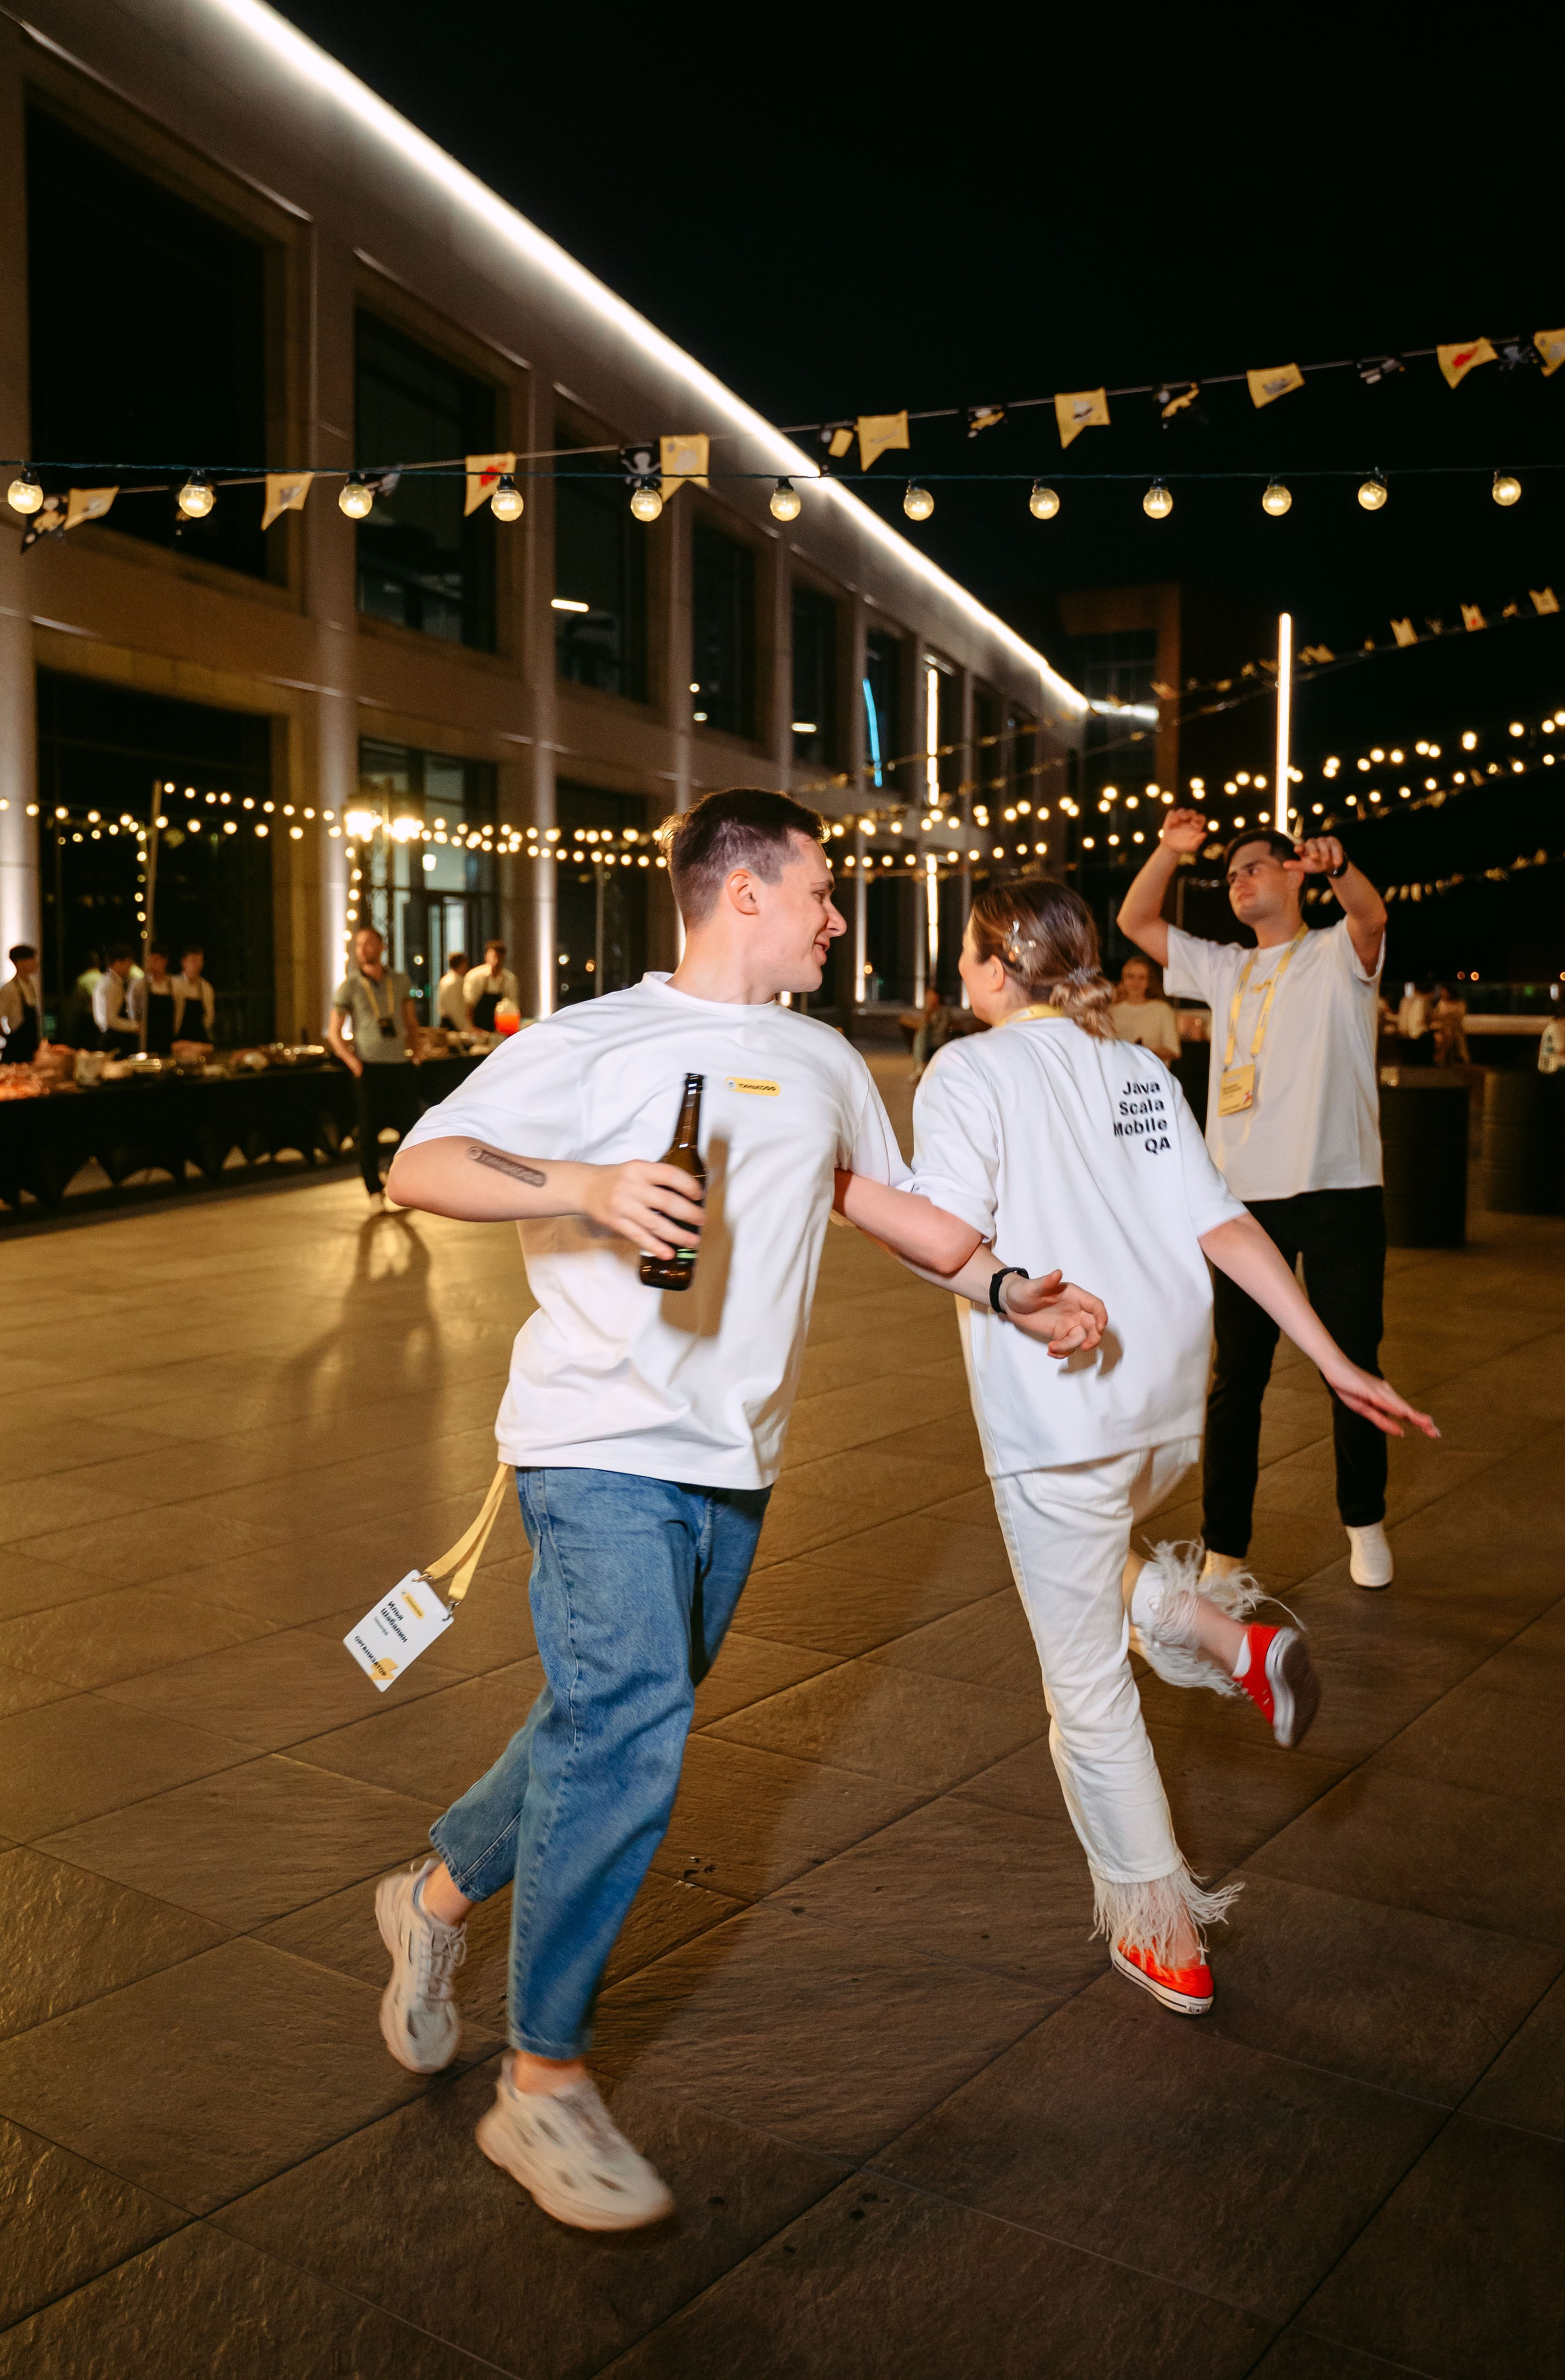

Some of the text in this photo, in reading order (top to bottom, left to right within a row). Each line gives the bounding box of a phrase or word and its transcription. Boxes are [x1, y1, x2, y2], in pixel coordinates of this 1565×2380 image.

[1122, 1081, 1161, 1095] Java
[1119, 1098, 1165, 1116] Scala
[1113, 1117, 1168, 1137] Mobile
[1144, 1136, 1172, 1156] QA
[354, 1635, 387, 1677] ОРГАНИЗАТОР
